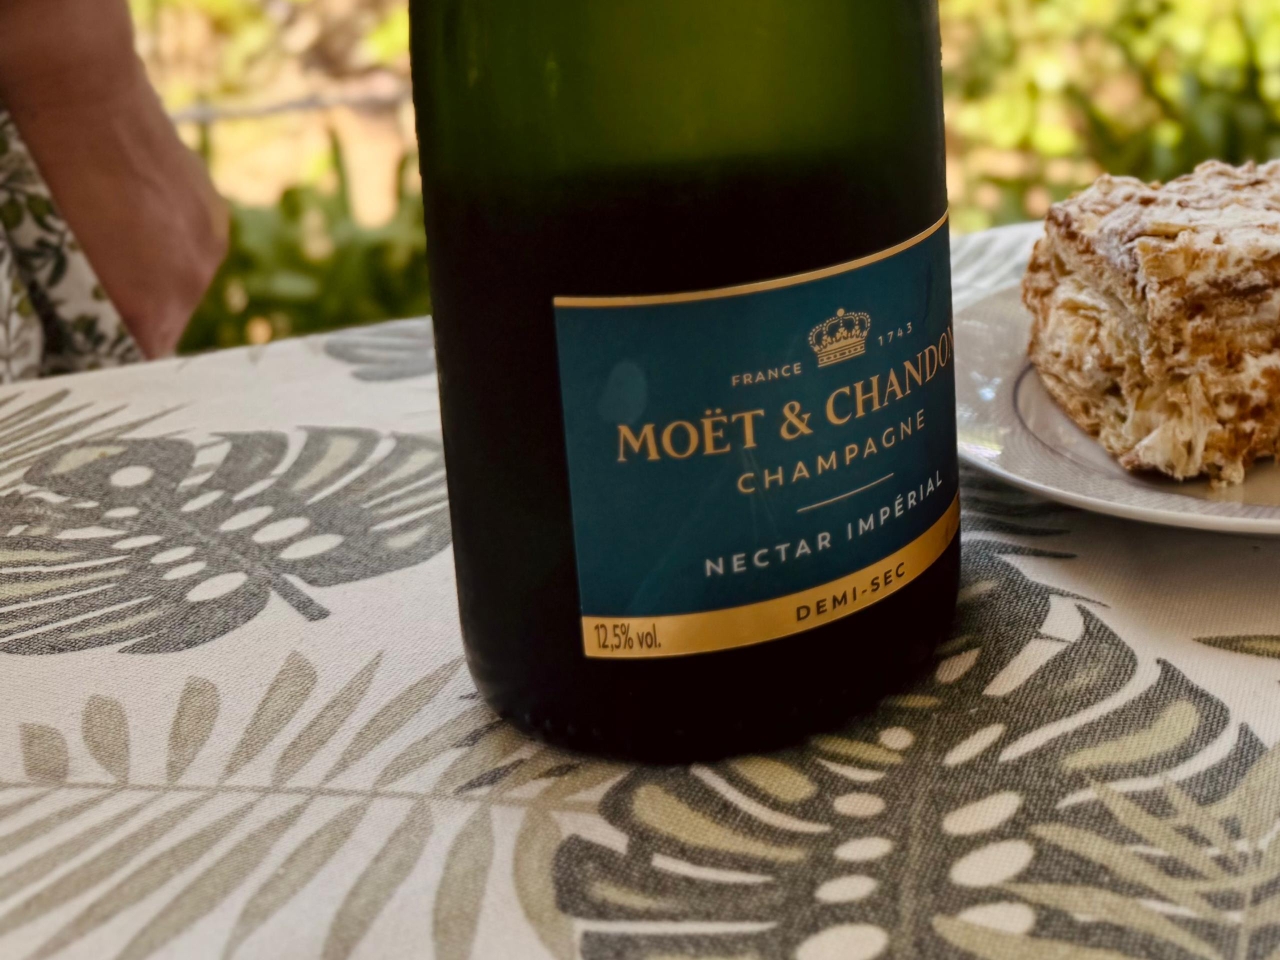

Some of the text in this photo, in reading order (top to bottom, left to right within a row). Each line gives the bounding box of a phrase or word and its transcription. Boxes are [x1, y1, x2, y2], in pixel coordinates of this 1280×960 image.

[731, 322, 913, 387] FRANCE 1743
[617, 408, 765, 463] MOËT
[780, 401, 814, 441] &
[737, 408, 926, 494] CHAMPAGNE
[705, 469, 943, 577] NECTAR IMPÉRIAL
[796, 562, 907, 622] DEMI-SEC
[594, 623, 662, 652] 12,5% vol.
